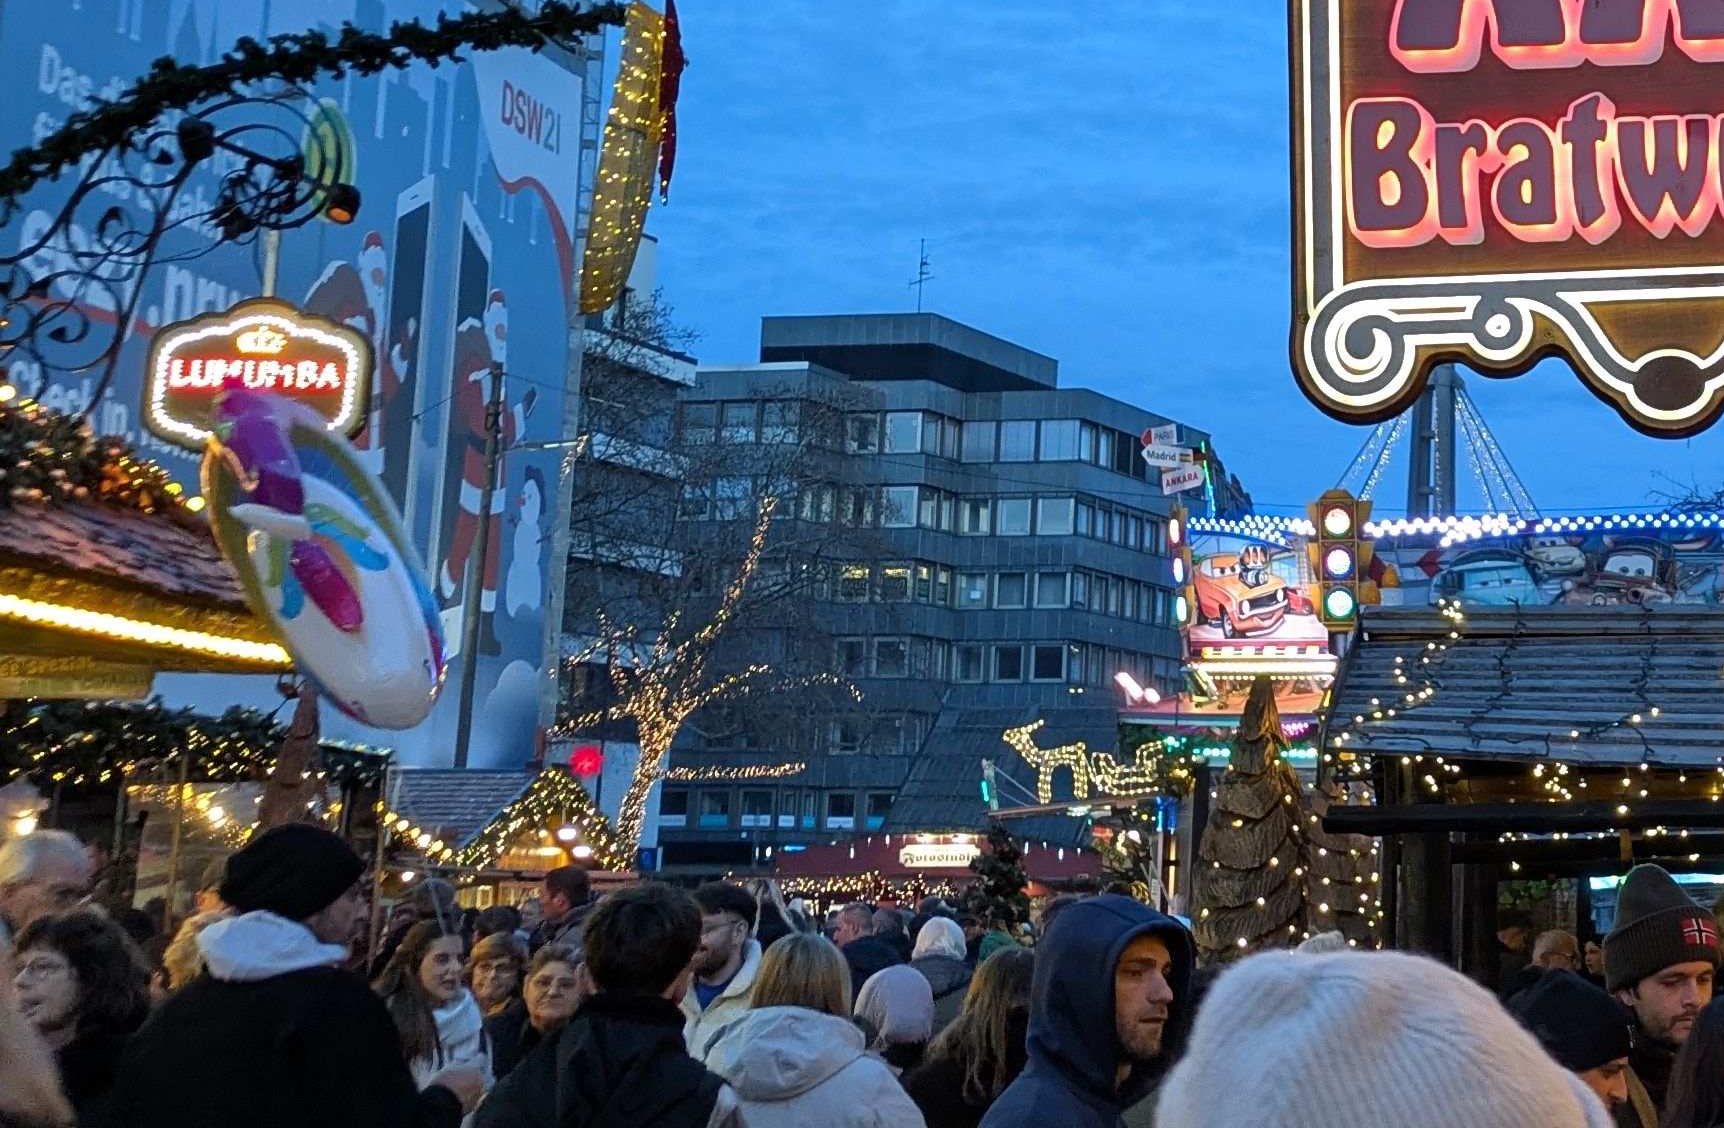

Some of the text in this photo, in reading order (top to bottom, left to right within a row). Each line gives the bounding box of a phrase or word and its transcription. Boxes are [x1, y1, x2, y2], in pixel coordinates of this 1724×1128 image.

[501, 79, 561, 155] DSW21
[169, 358, 340, 389] LUMUMBA
[1146, 450, 1177, 461] Madrid
[1165, 472, 1199, 488] ANKARA
